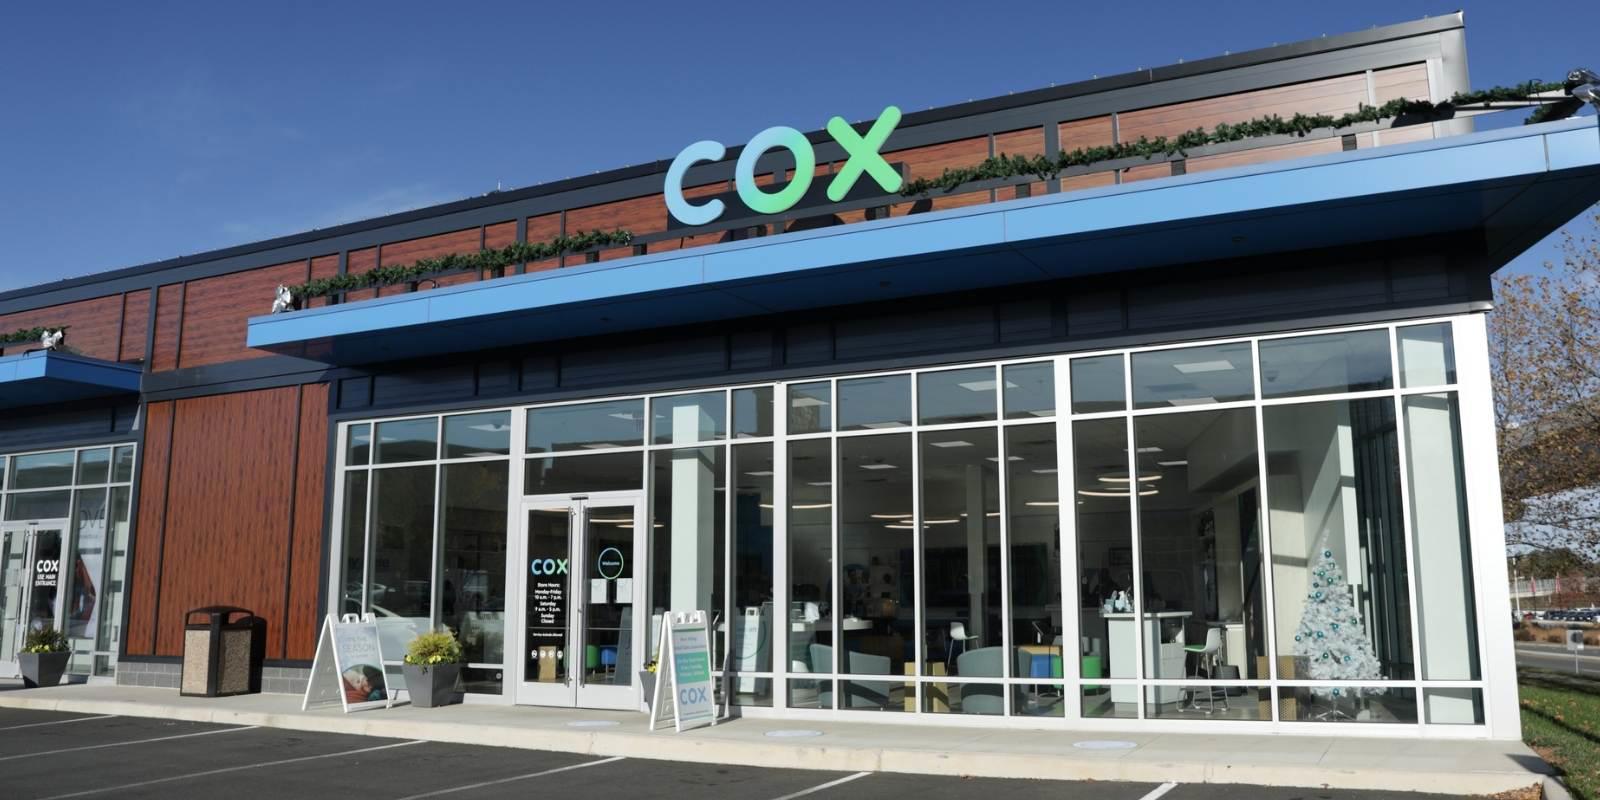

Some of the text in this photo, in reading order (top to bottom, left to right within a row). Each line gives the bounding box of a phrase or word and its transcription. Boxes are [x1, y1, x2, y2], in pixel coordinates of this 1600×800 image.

[664, 105, 903, 226] COX
[36, 559, 59, 573] COX
[531, 558, 568, 575] COX
[680, 686, 707, 705] COX
